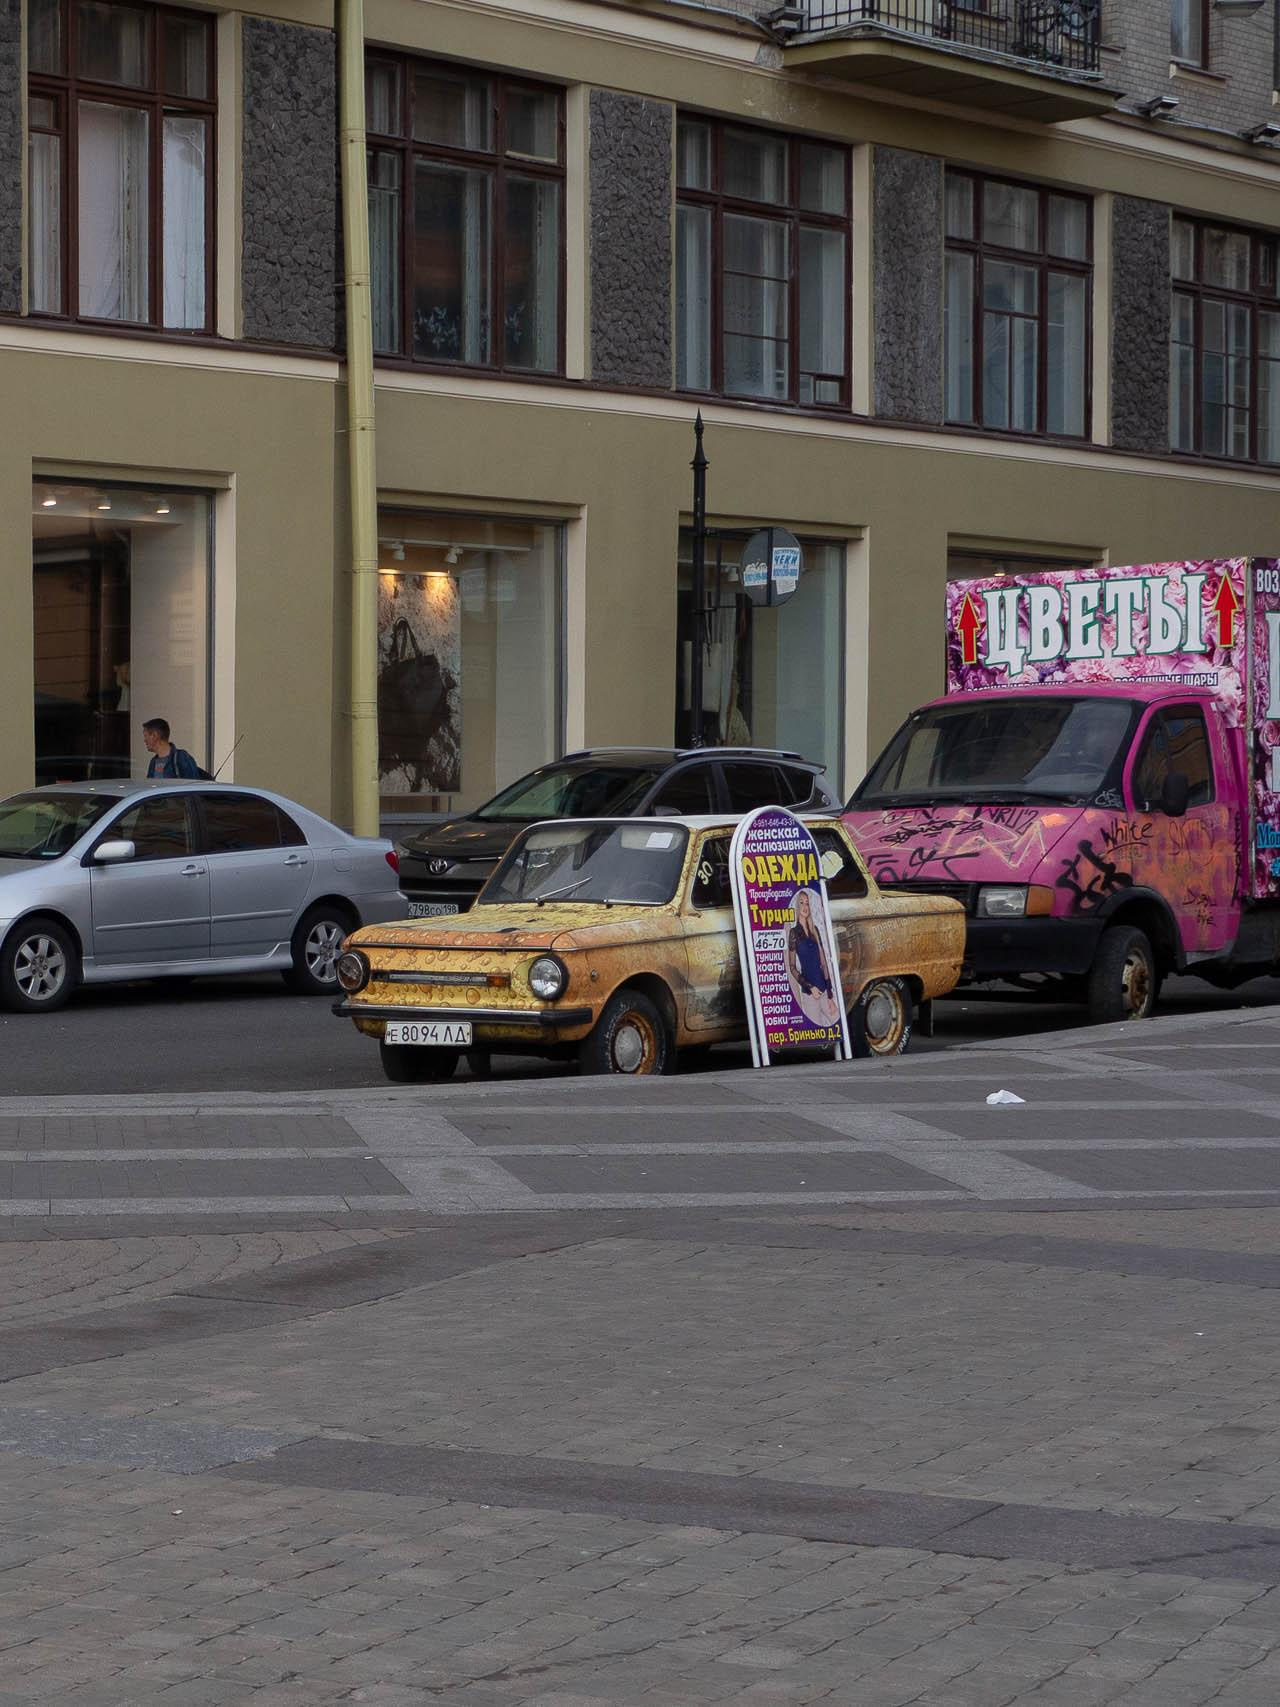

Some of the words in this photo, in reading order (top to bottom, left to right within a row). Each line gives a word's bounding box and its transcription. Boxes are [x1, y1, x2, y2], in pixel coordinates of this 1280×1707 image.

[982, 573, 1208, 677] ЦВЕТЫ
[1184, 674, 1218, 686] ШАРЫ
[742, 853, 819, 887] ОДЕЖДА
[750, 904, 795, 927] Турция
[755, 938, 785, 949] 46-70
[768, 1031, 788, 1045] пер.
[788, 1027, 827, 1042] Бринько
